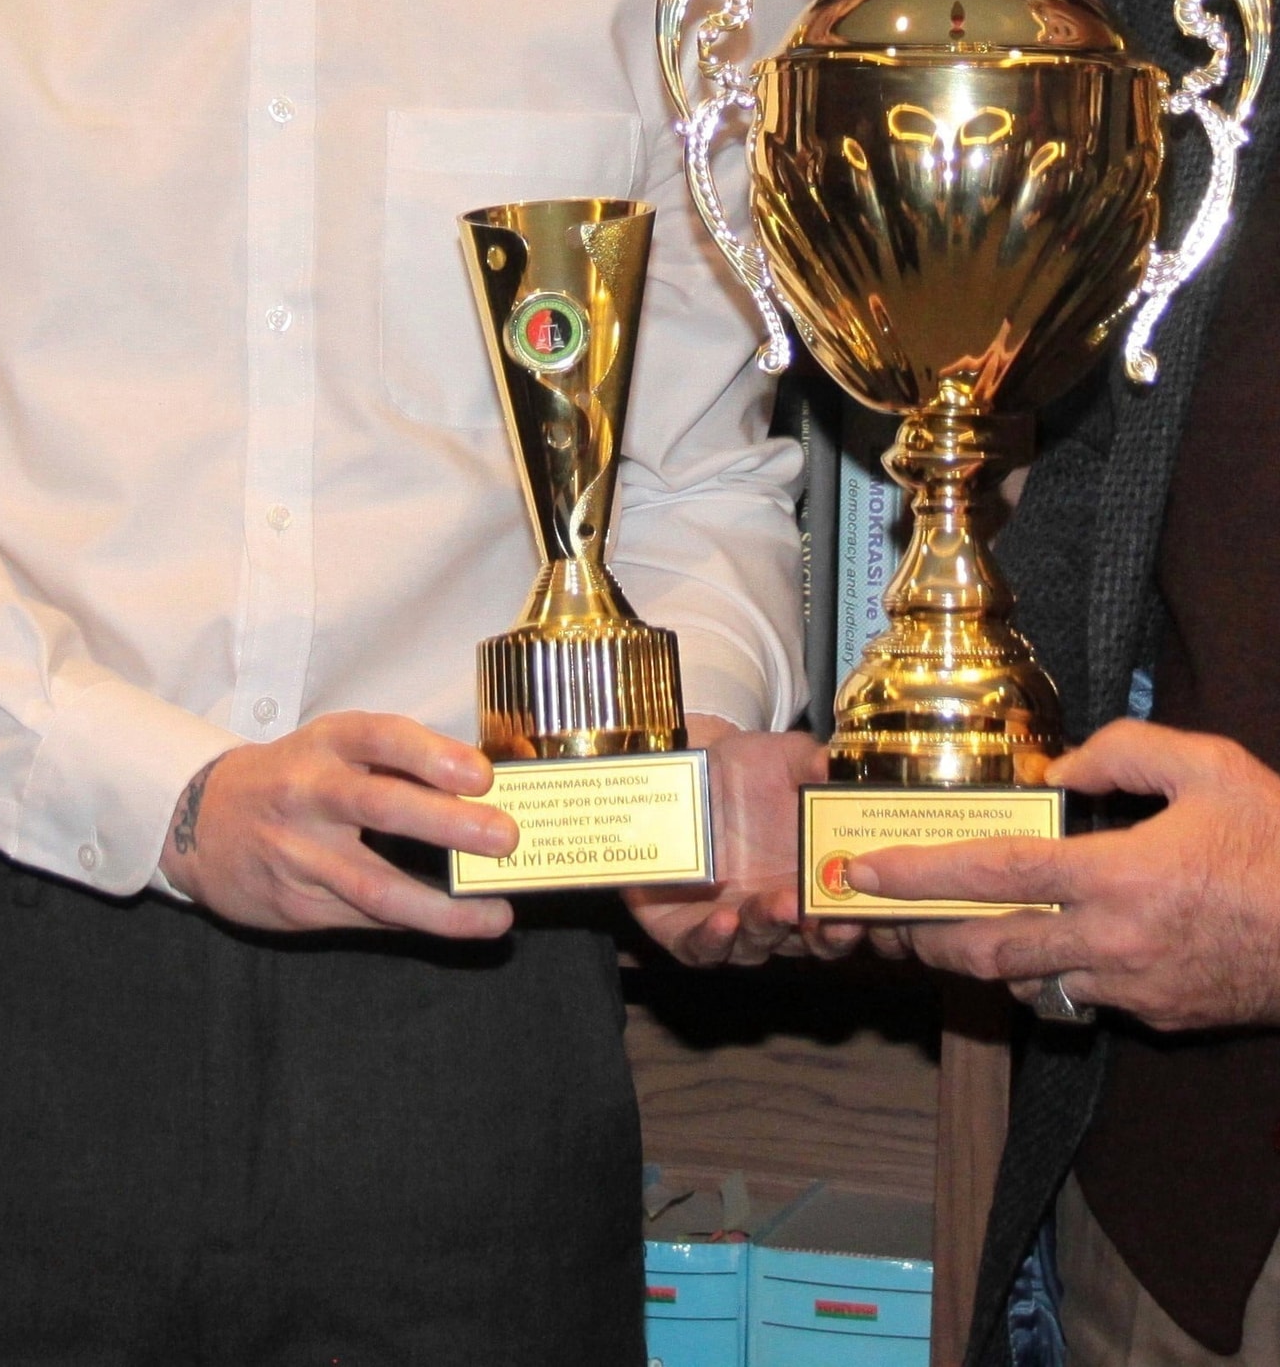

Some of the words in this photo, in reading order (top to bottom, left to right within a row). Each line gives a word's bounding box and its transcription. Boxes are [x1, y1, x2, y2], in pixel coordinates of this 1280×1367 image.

[841, 477, 860, 564] democracy
[844, 568, 860, 598] and
[866, 595, 882, 621] ve
[841, 599, 858, 667] judiciary
[499, 776, 601, 793] KAHRAMANMARAŞ
[605, 774, 650, 788] BAROSU
[517, 798, 560, 812] AVUKAT
[562, 796, 591, 809] SPOR
[593, 792, 680, 808] OYUNLARI/2021
[519, 814, 591, 830] CUMHURİYET
[594, 813, 632, 826] KUPASI
[861, 808, 966, 822] KAHRAMANMARAŞ
[967, 808, 1014, 821] BAROSU
[531, 837, 565, 848] ERKEK
[567, 833, 623, 846] VOLEYBOL
[831, 824, 878, 840] TÜRKİYE
[878, 826, 923, 839] AVUKAT
[925, 826, 955, 840] SPOR
[497, 854, 518, 869] EN
[522, 850, 542, 867] İYİ
[546, 847, 599, 866] PASÖR
[602, 843, 659, 863] ÖDÜLÜ
